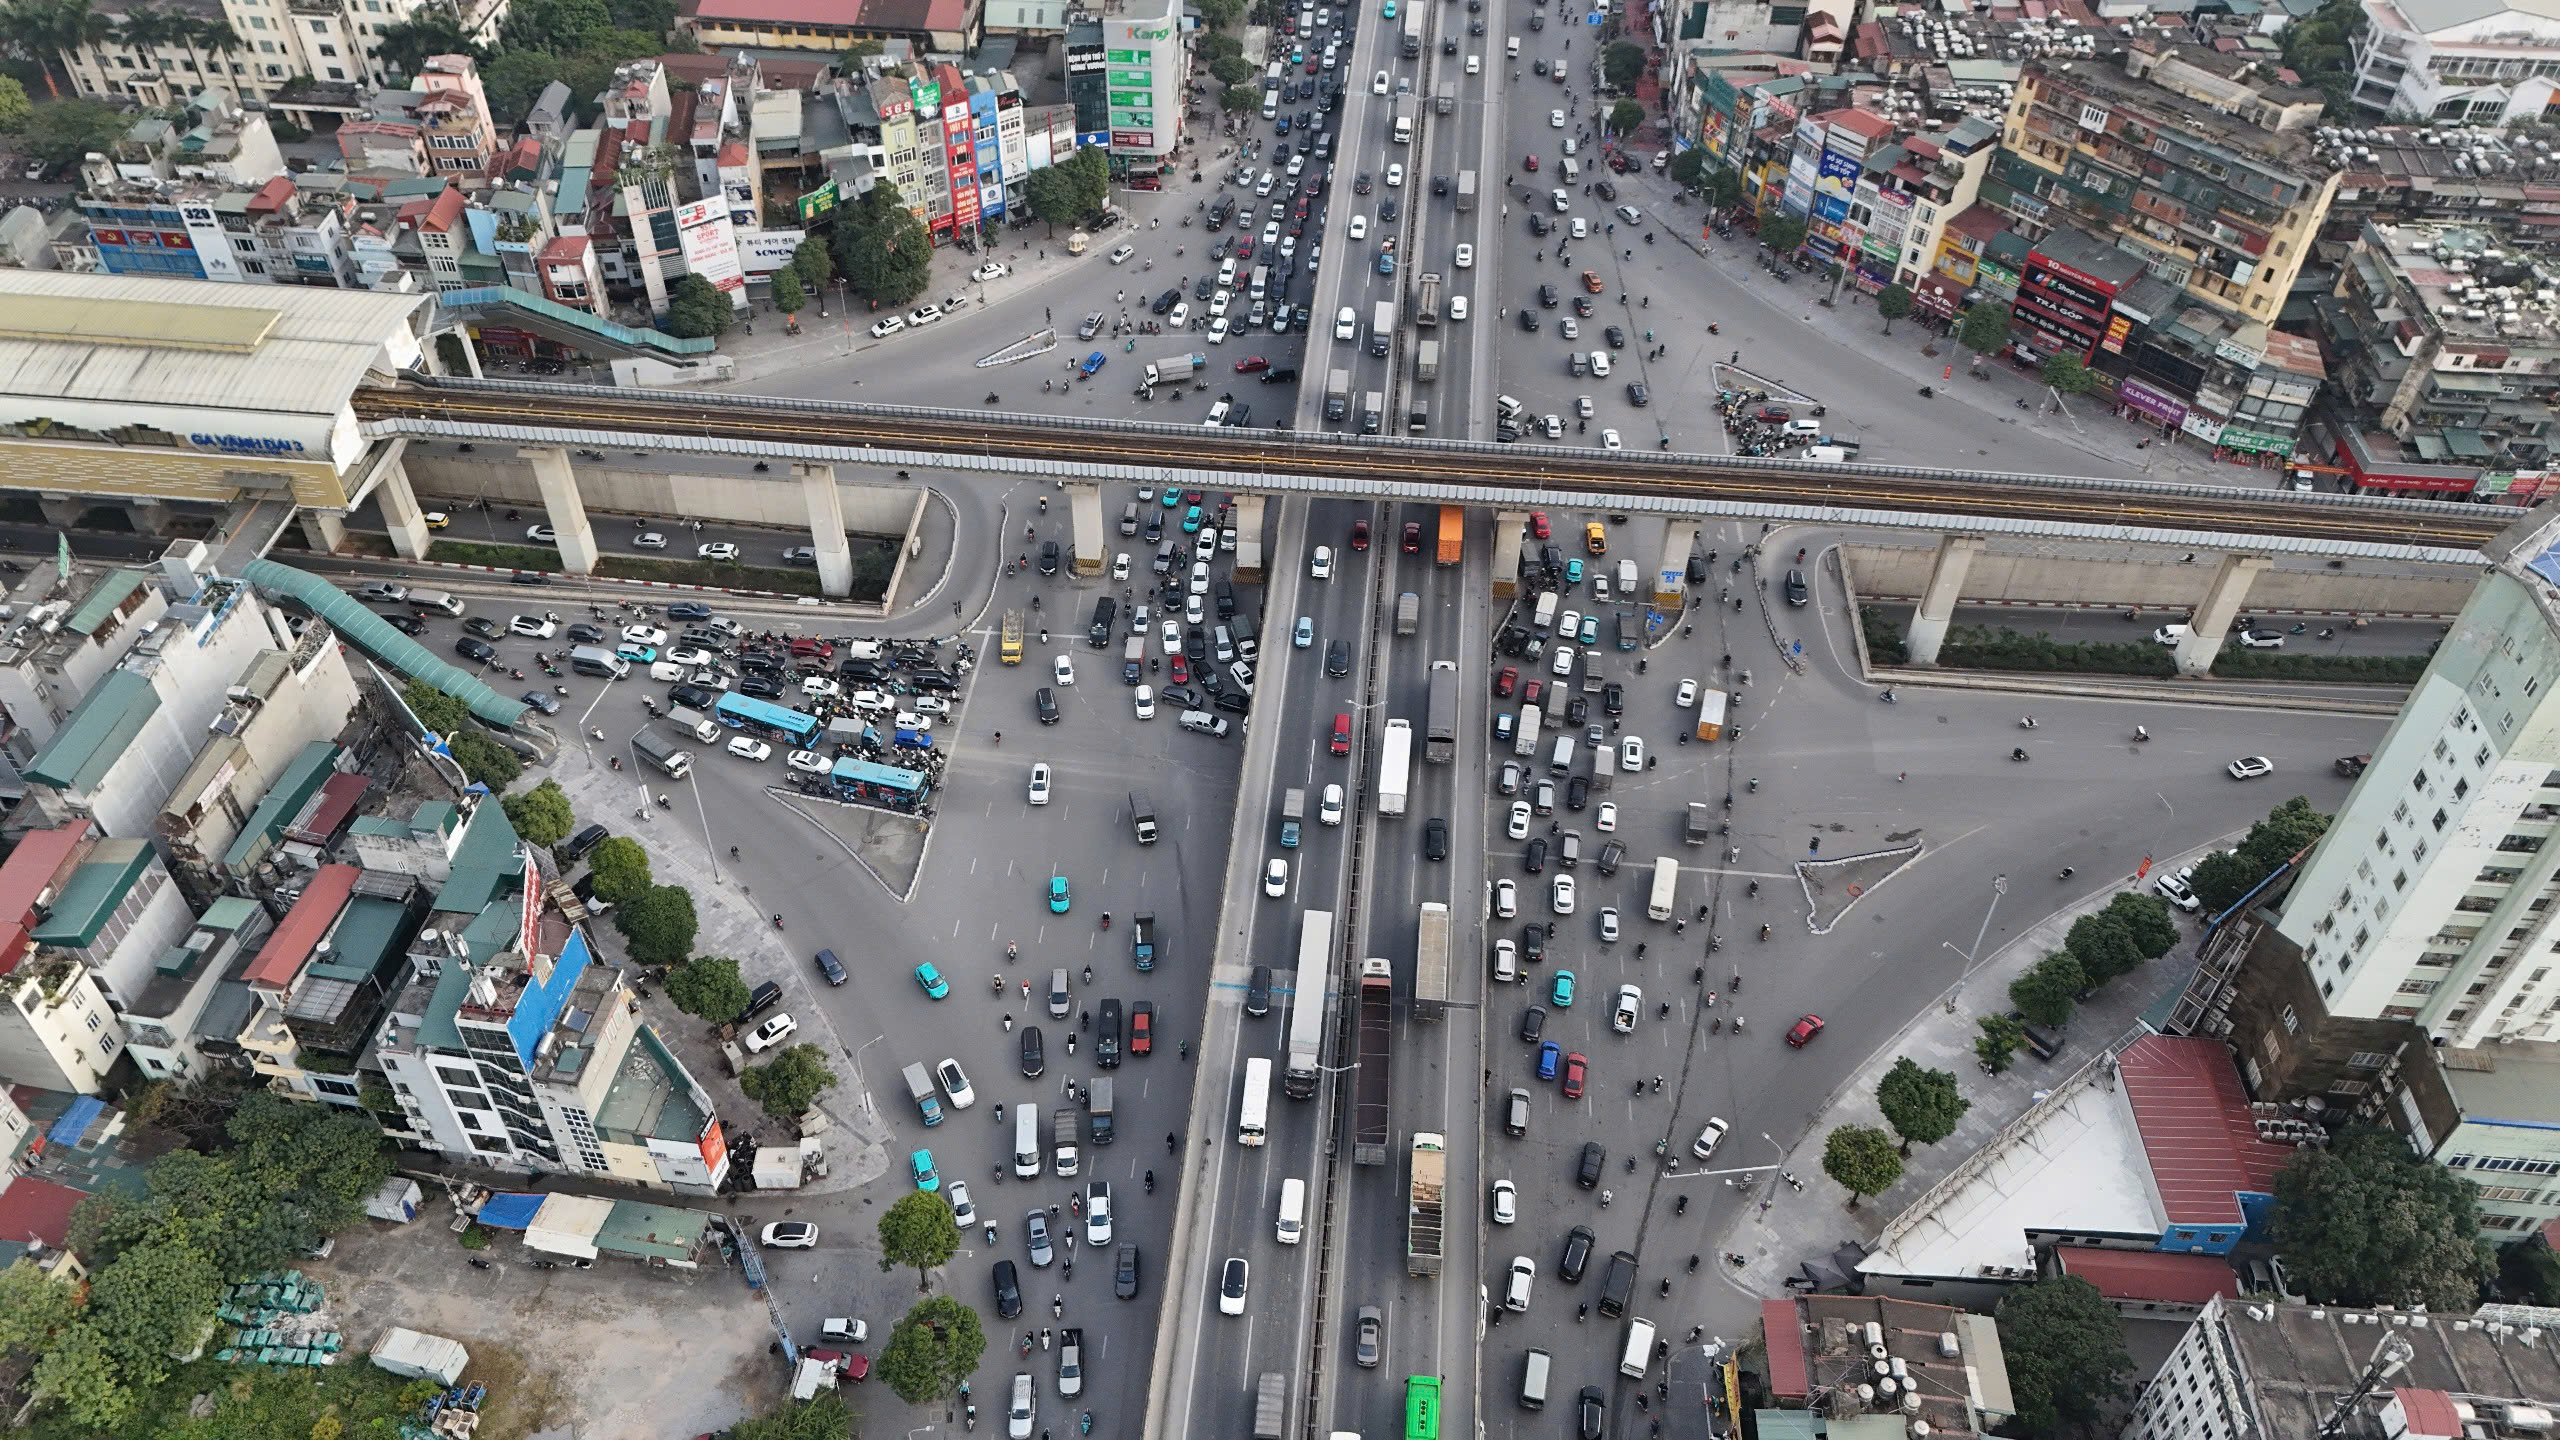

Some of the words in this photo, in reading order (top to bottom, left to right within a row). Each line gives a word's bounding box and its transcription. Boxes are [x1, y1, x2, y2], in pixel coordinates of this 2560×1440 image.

[183, 208, 211, 220] 329
[755, 249, 793, 257] SOWON
[2047, 259, 2060, 271] 10
[2035, 272, 2058, 288] FPT
[2035, 296, 2057, 311] TRẢ
[2060, 306, 2083, 321] GÓP
[2113, 316, 2131, 327] CHO
[2125, 386, 2156, 406] KLEVER
[2157, 401, 2182, 417] FRUIT
[2223, 434, 2252, 444] FRESH
